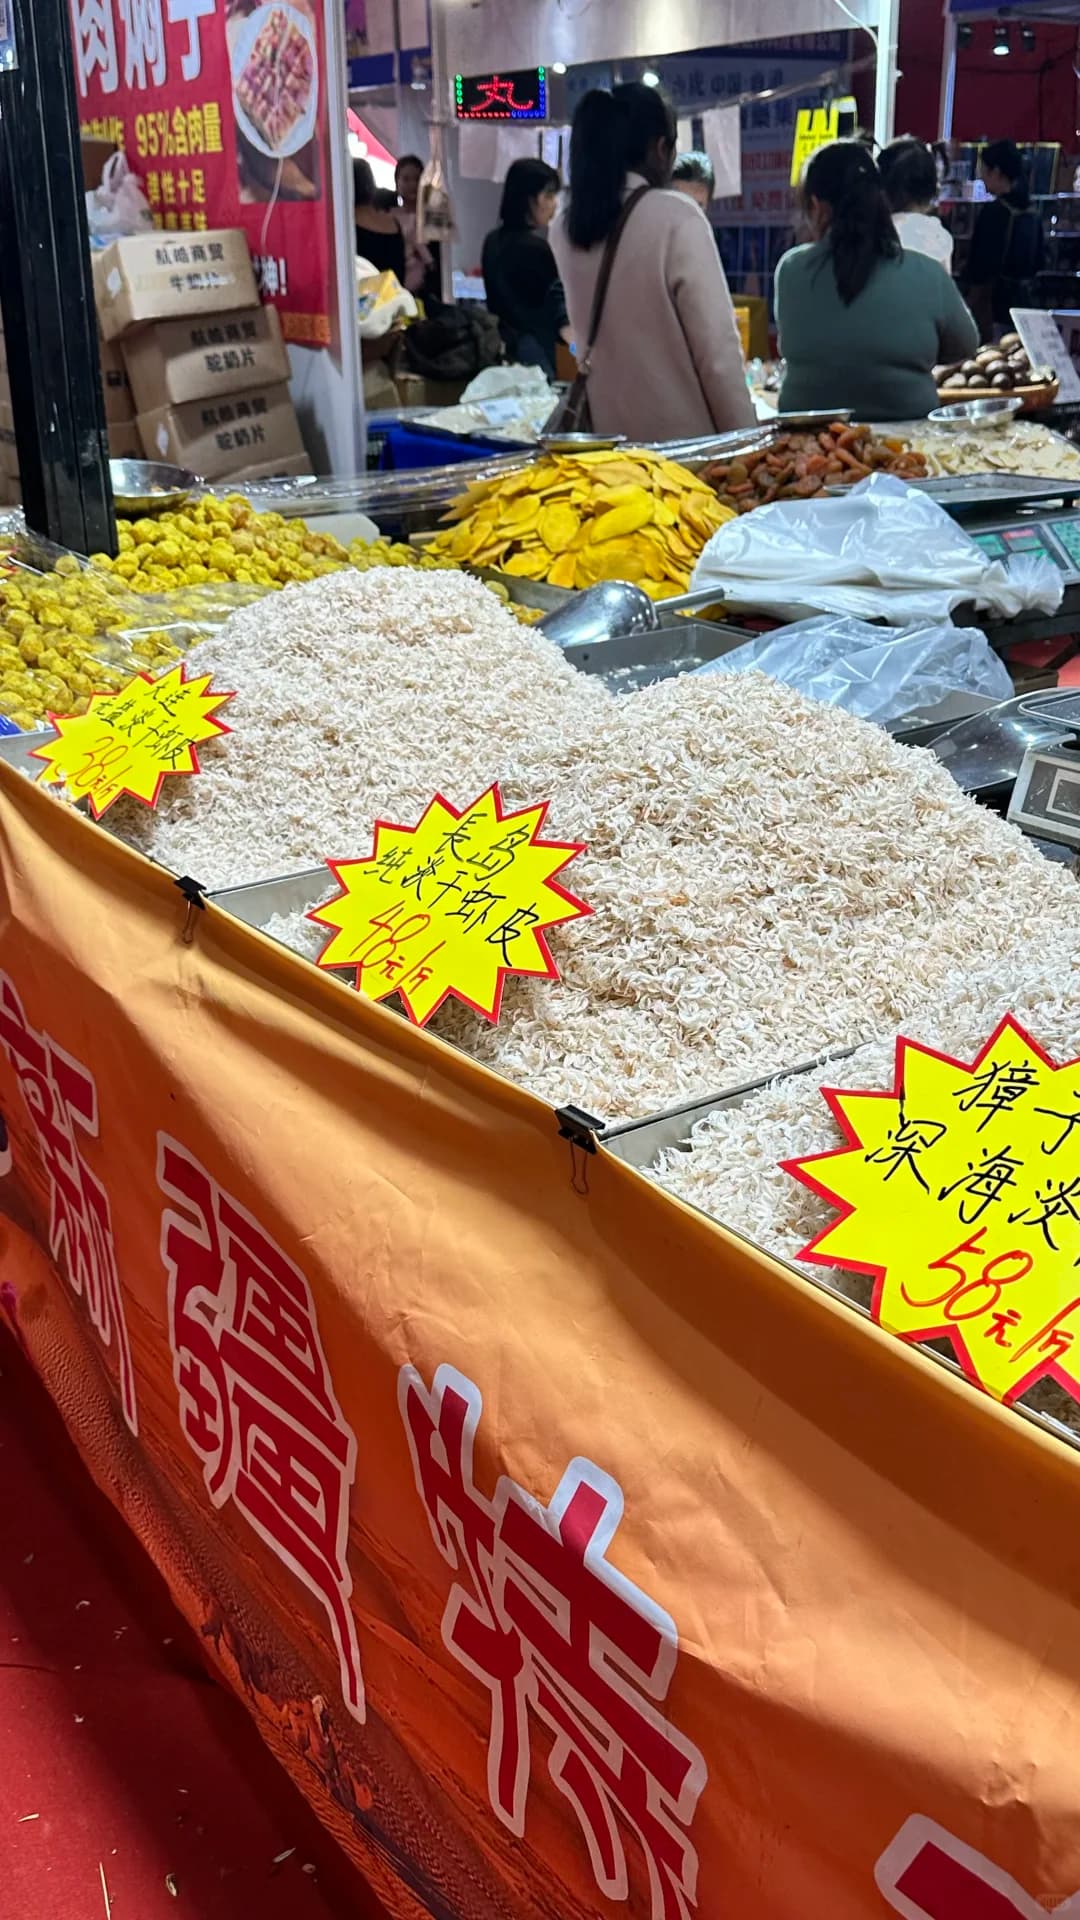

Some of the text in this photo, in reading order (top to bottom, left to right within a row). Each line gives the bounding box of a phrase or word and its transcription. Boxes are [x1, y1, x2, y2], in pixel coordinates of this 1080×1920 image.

[135, 102, 223, 158] 95%含肉量
[471, 75, 534, 112] 丸
[349, 900, 447, 995] 48元/斤
[865, 1084, 1080, 1266] 深海淡
[901, 1226, 1080, 1363] 58元/斤
